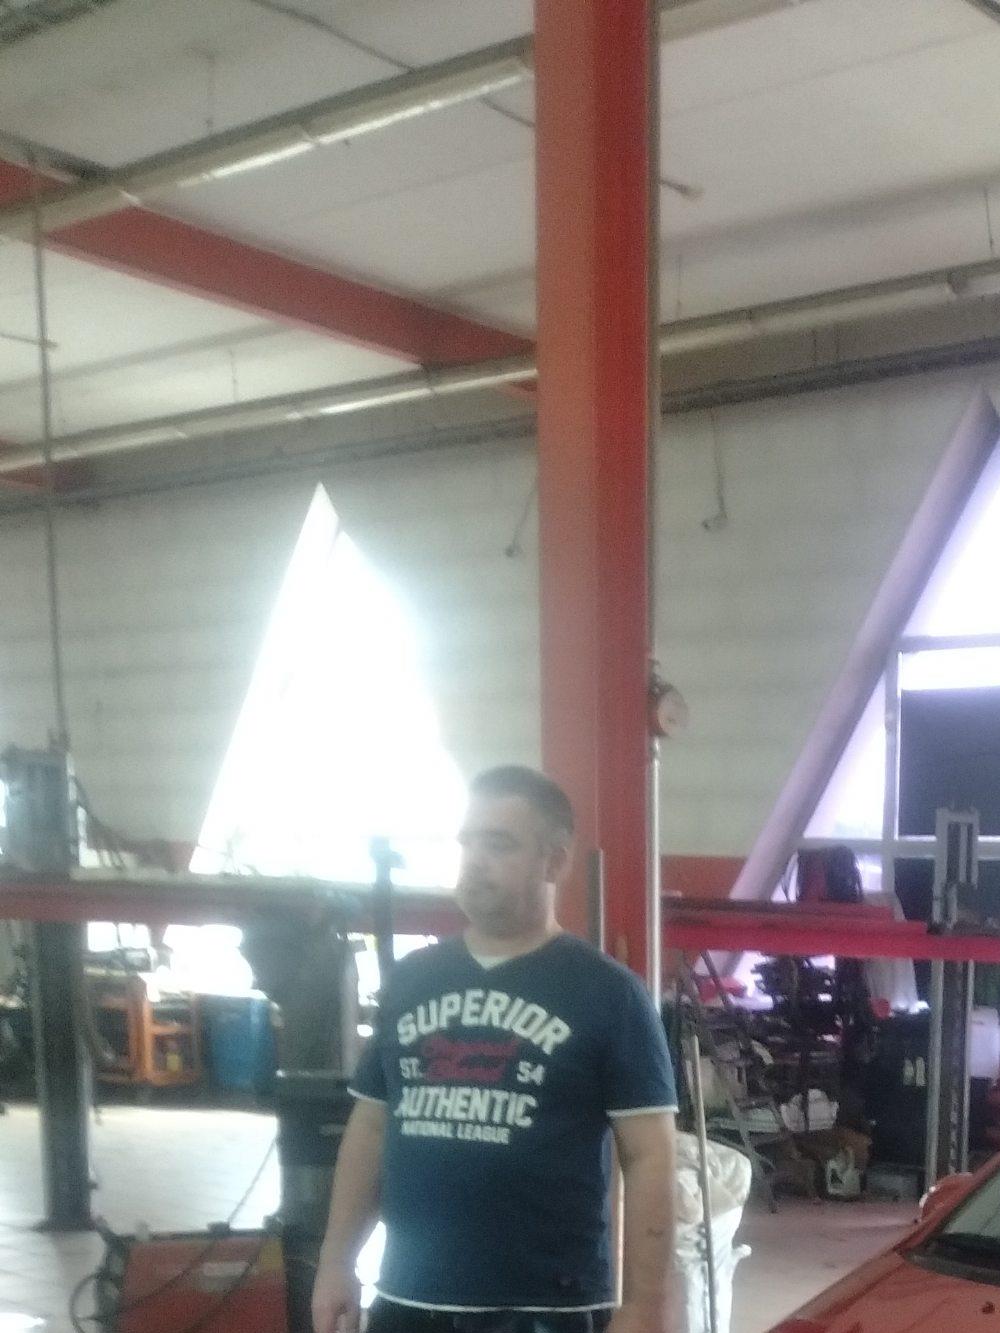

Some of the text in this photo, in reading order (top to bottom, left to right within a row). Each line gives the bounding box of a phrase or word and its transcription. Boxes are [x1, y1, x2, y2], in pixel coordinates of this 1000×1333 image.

[396, 988, 573, 1055] SUPERIOR
[394, 1086, 537, 1127] AUTHENTIC
[456, 1122, 511, 1145] LEAGUE
